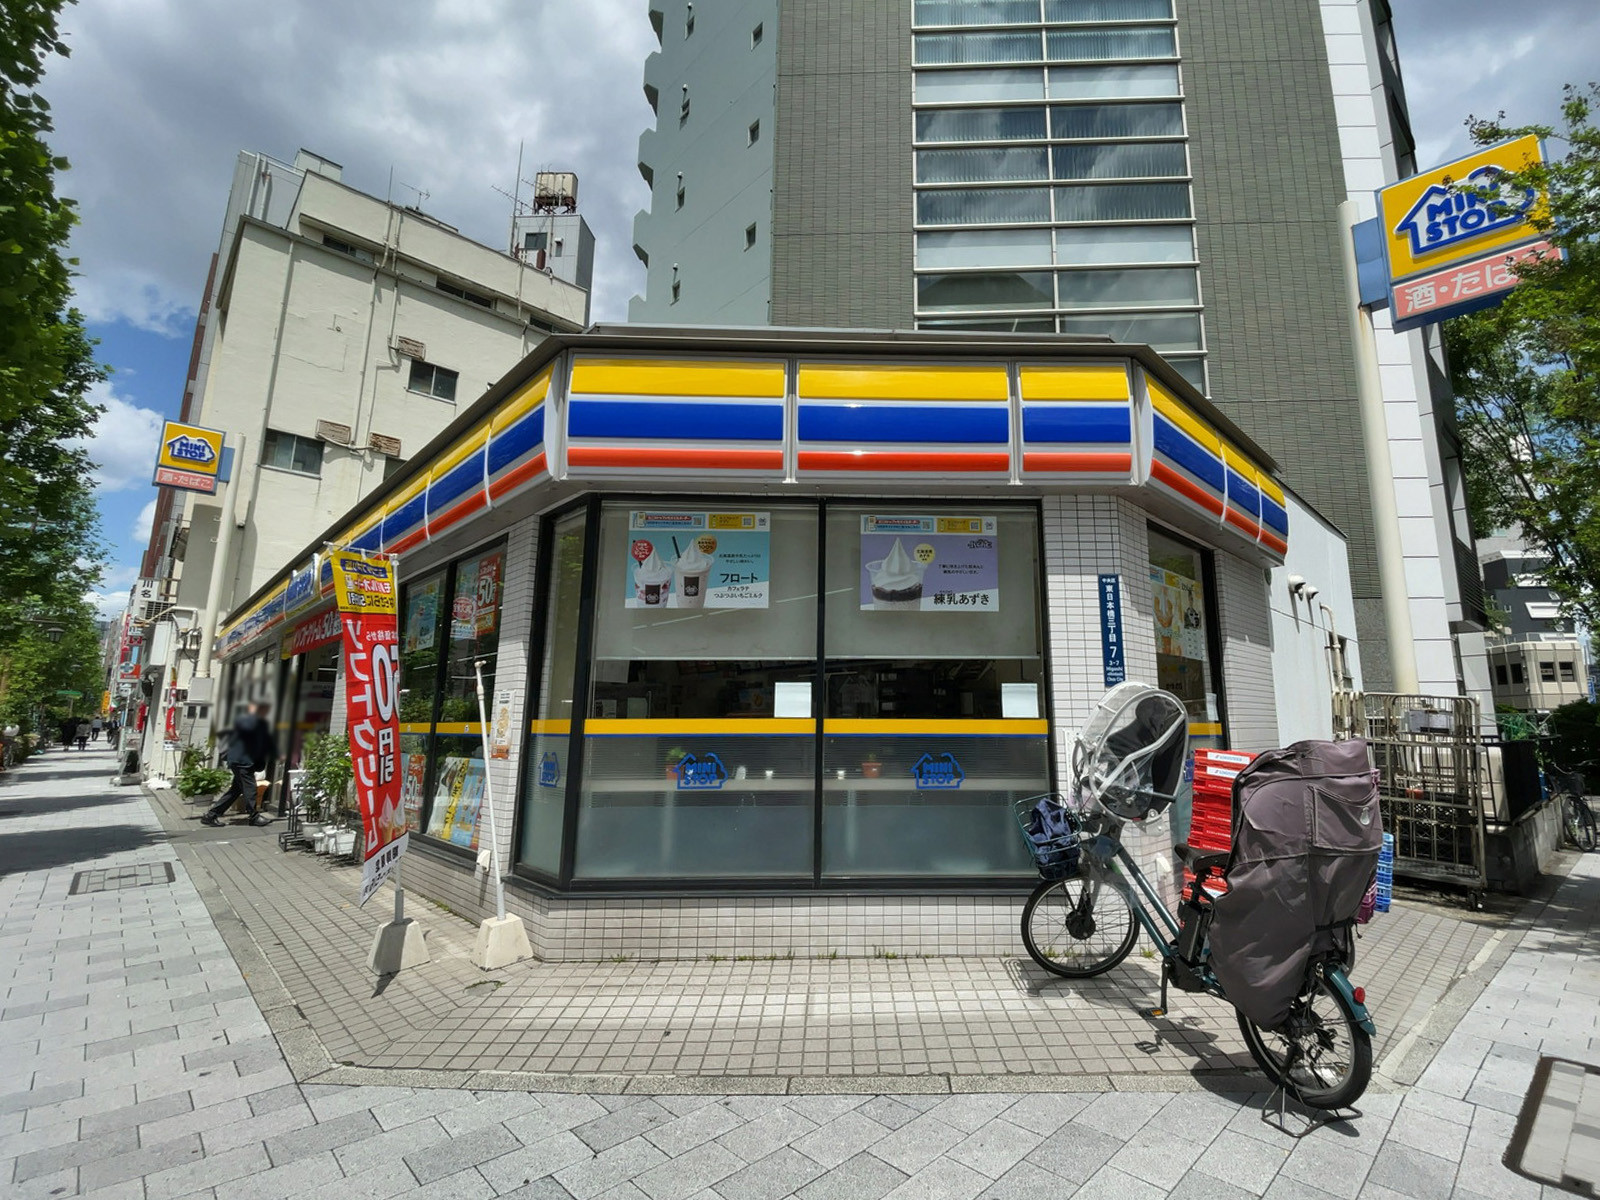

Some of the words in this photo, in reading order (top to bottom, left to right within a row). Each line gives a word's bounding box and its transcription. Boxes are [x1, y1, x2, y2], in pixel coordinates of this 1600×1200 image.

[177, 448, 206, 458] STOP
[180, 442, 206, 452] MINI
[161, 472, 211, 489] 酒・たばこ
[720, 572, 758, 584] フロート
[934, 593, 990, 606] 練乳あずき
[1105, 584, 1117, 643] 東日本橋三丁目
[1109, 646, 1118, 658] 7
[685, 762, 717, 773] MINI
[922, 762, 953, 773] MINI
[684, 774, 717, 786] STOP
[922, 774, 954, 784] STOP
